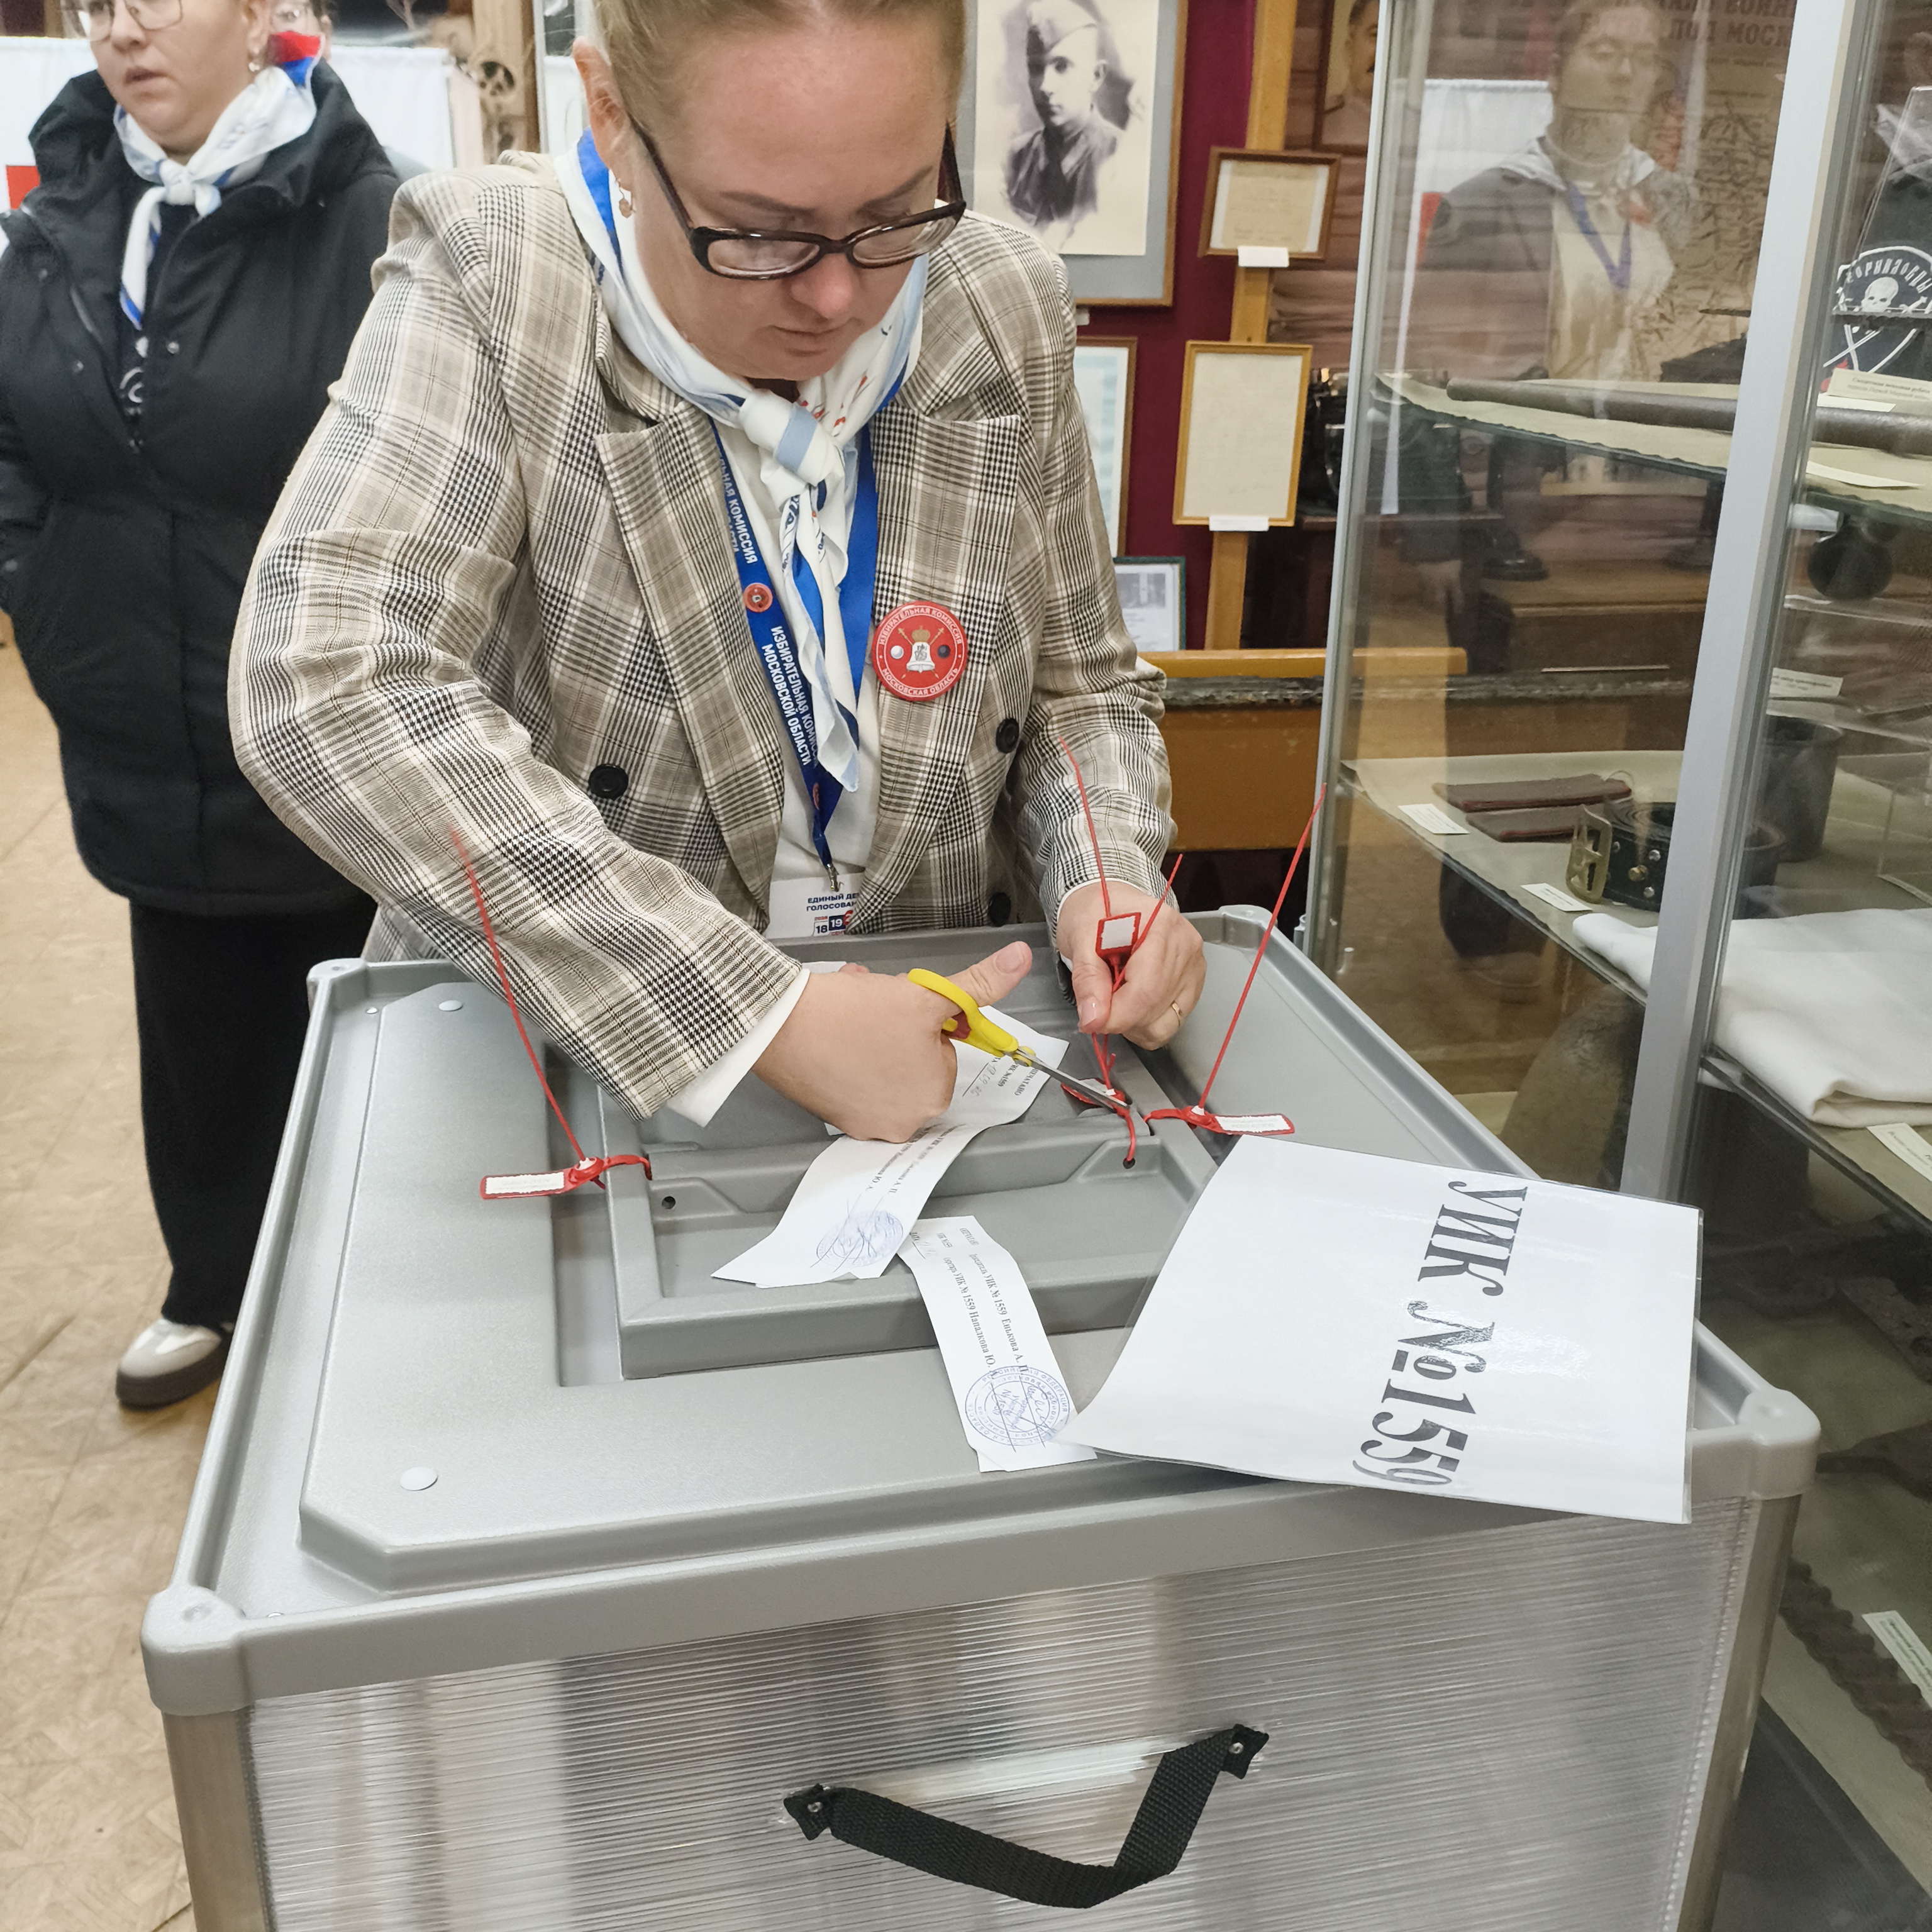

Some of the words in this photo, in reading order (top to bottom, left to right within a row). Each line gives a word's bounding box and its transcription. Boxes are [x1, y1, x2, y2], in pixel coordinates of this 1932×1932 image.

[1727, 23, 1791, 47] МОСК
[728, 499, 758, 564] КОМИССИЯ
[879, 608, 931, 646] ИЗБИРАТЕЛЬНАЯ
[931, 608, 962, 645] КОМИССИЯ
[770, 626, 809, 714] ИЗБИРАТЕЛЬНАЯ
[882, 668, 928, 696] МОСКОВСКАЯ
[930, 668, 958, 694] ОБЛАСТЬ
[762, 643, 798, 718] МОСКОВСКОЙ
[787, 718, 812, 765] ОБЛАСТИ
[807, 901, 855, 911] ГОЛОСОВАН
[808, 894, 844, 904] ЕДИНЫЙ
[816, 925, 828, 934] 18
[830, 919, 843, 928] 19
[1014, 1069, 1039, 1096] ПЕЧАТАНО
[1418, 1180, 1528, 1297] УИК
[953, 1271, 966, 1287] УИК
[984, 1274, 997, 1289] УИК
[963, 1294, 976, 1310] 1559
[990, 1289, 1000, 1298] №
[994, 1299, 1008, 1315] 1559
[969, 1311, 989, 1353] Напалкова
[1001, 1318, 1019, 1352] Енькова
[984, 1354, 996, 1368] Ю.
[1014, 1353, 1023, 1363] А.
